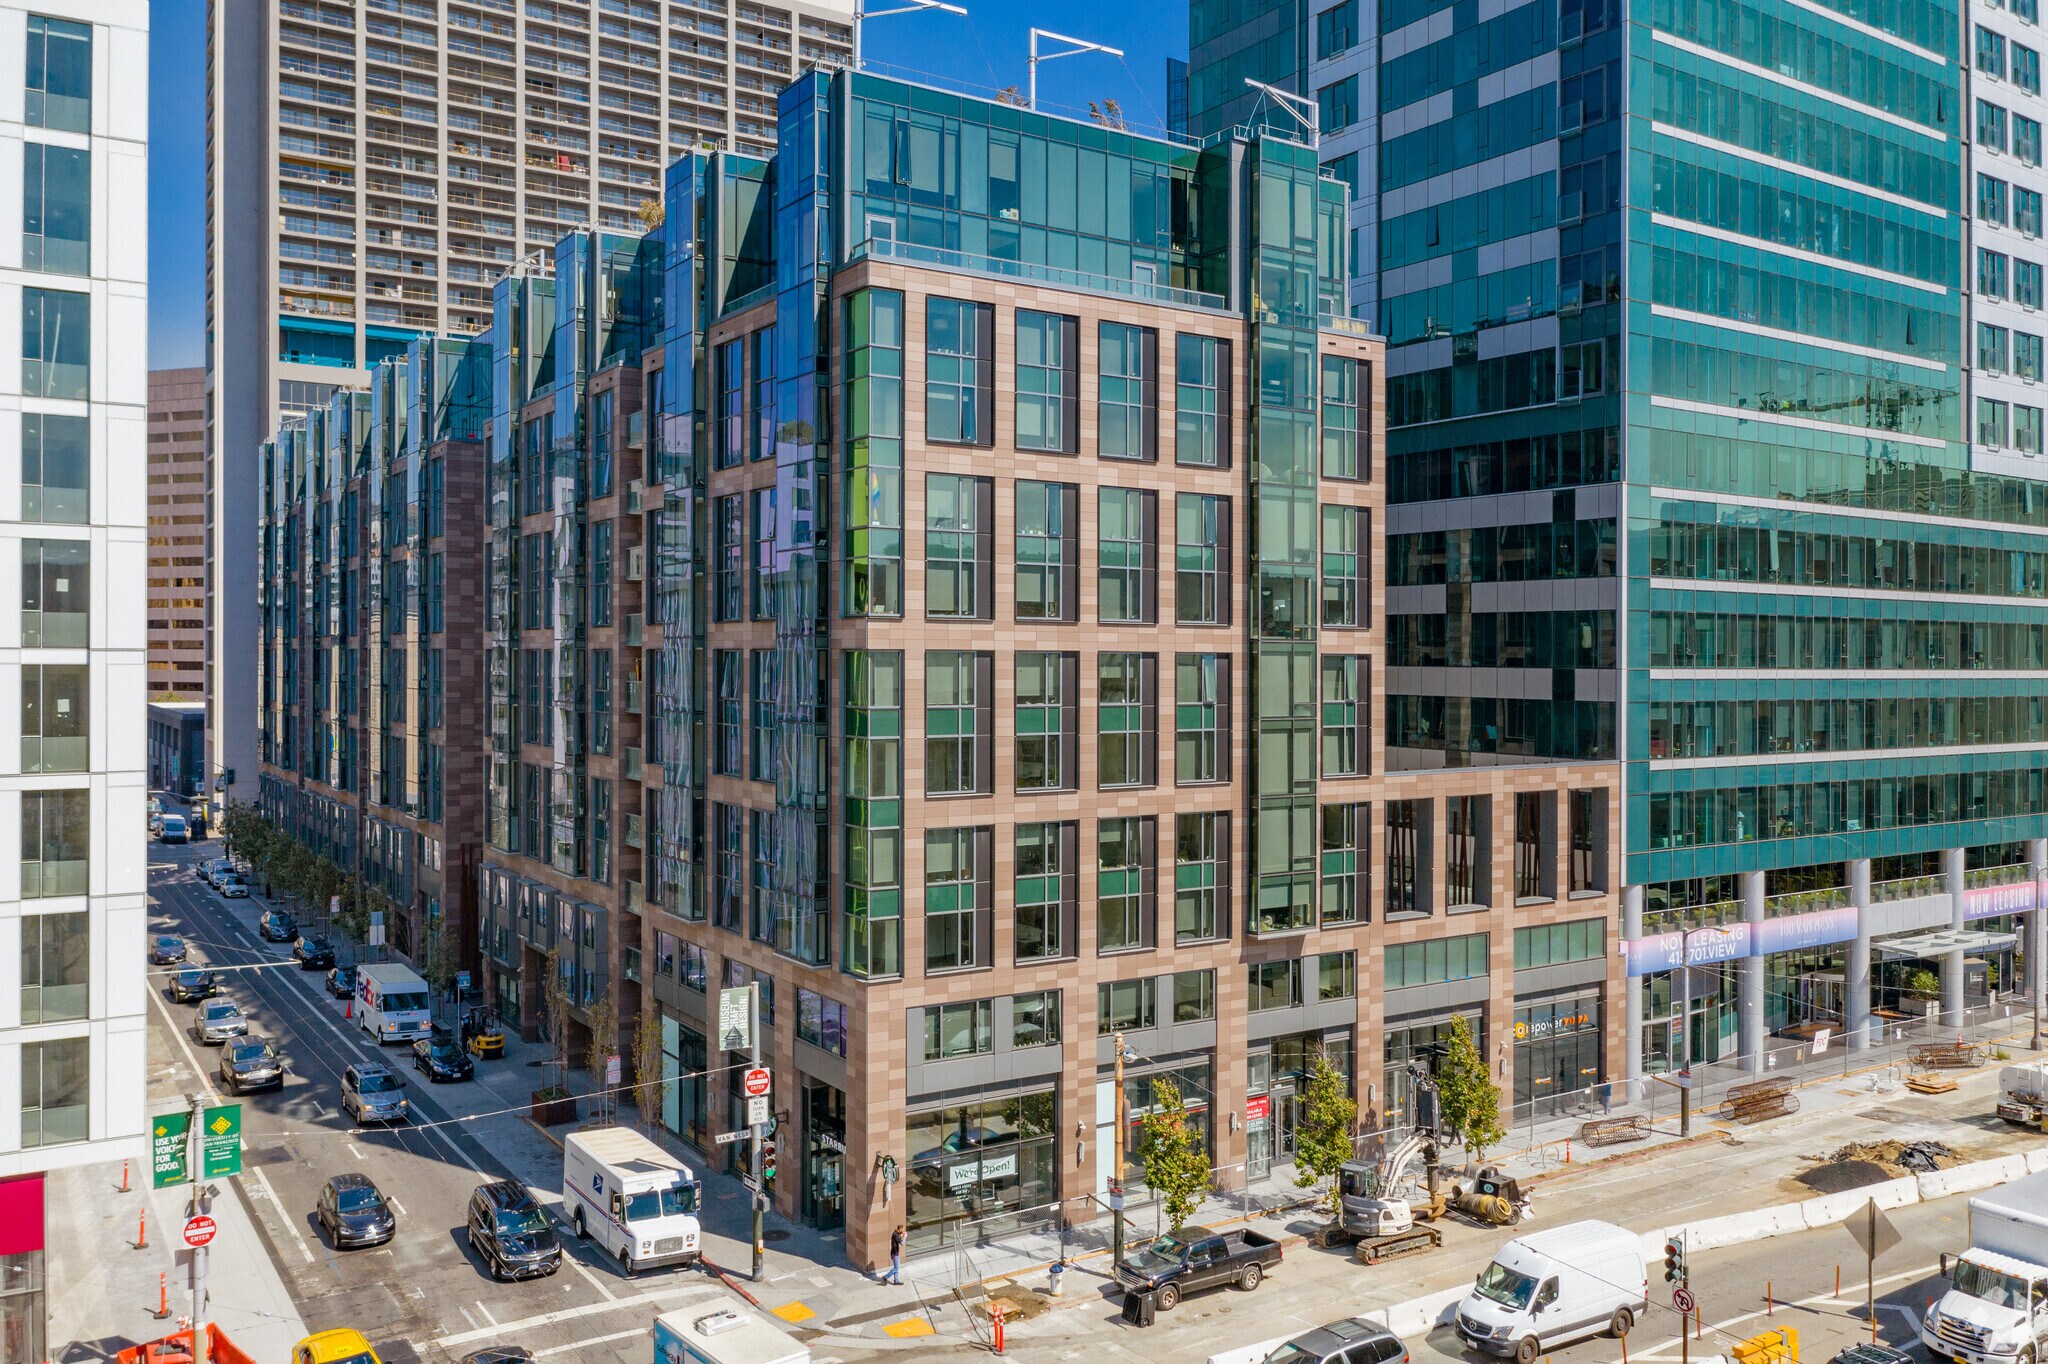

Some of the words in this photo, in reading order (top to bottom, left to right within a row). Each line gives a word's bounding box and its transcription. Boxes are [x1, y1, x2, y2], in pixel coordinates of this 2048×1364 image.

[1970, 893, 1989, 915] NOW
[1994, 887, 2030, 911] LEASING
[1780, 921, 1794, 936] 100
[1796, 919, 1812, 934] VAN
[1815, 916, 1834, 931] NESS
[1693, 927, 1744, 947] LEASING
[721, 992, 730, 1030] MUSEUM
[733, 1131, 750, 1139] NESS
[155, 1137, 170, 1147] USE
[156, 1154, 171, 1164] FOR
[156, 1161, 180, 1172] GOOD.
[954, 1167, 979, 1179] We're
[982, 1160, 1010, 1174] Open!
[200, 1219, 212, 1227] NOT
[191, 1233, 210, 1242] ENTER
